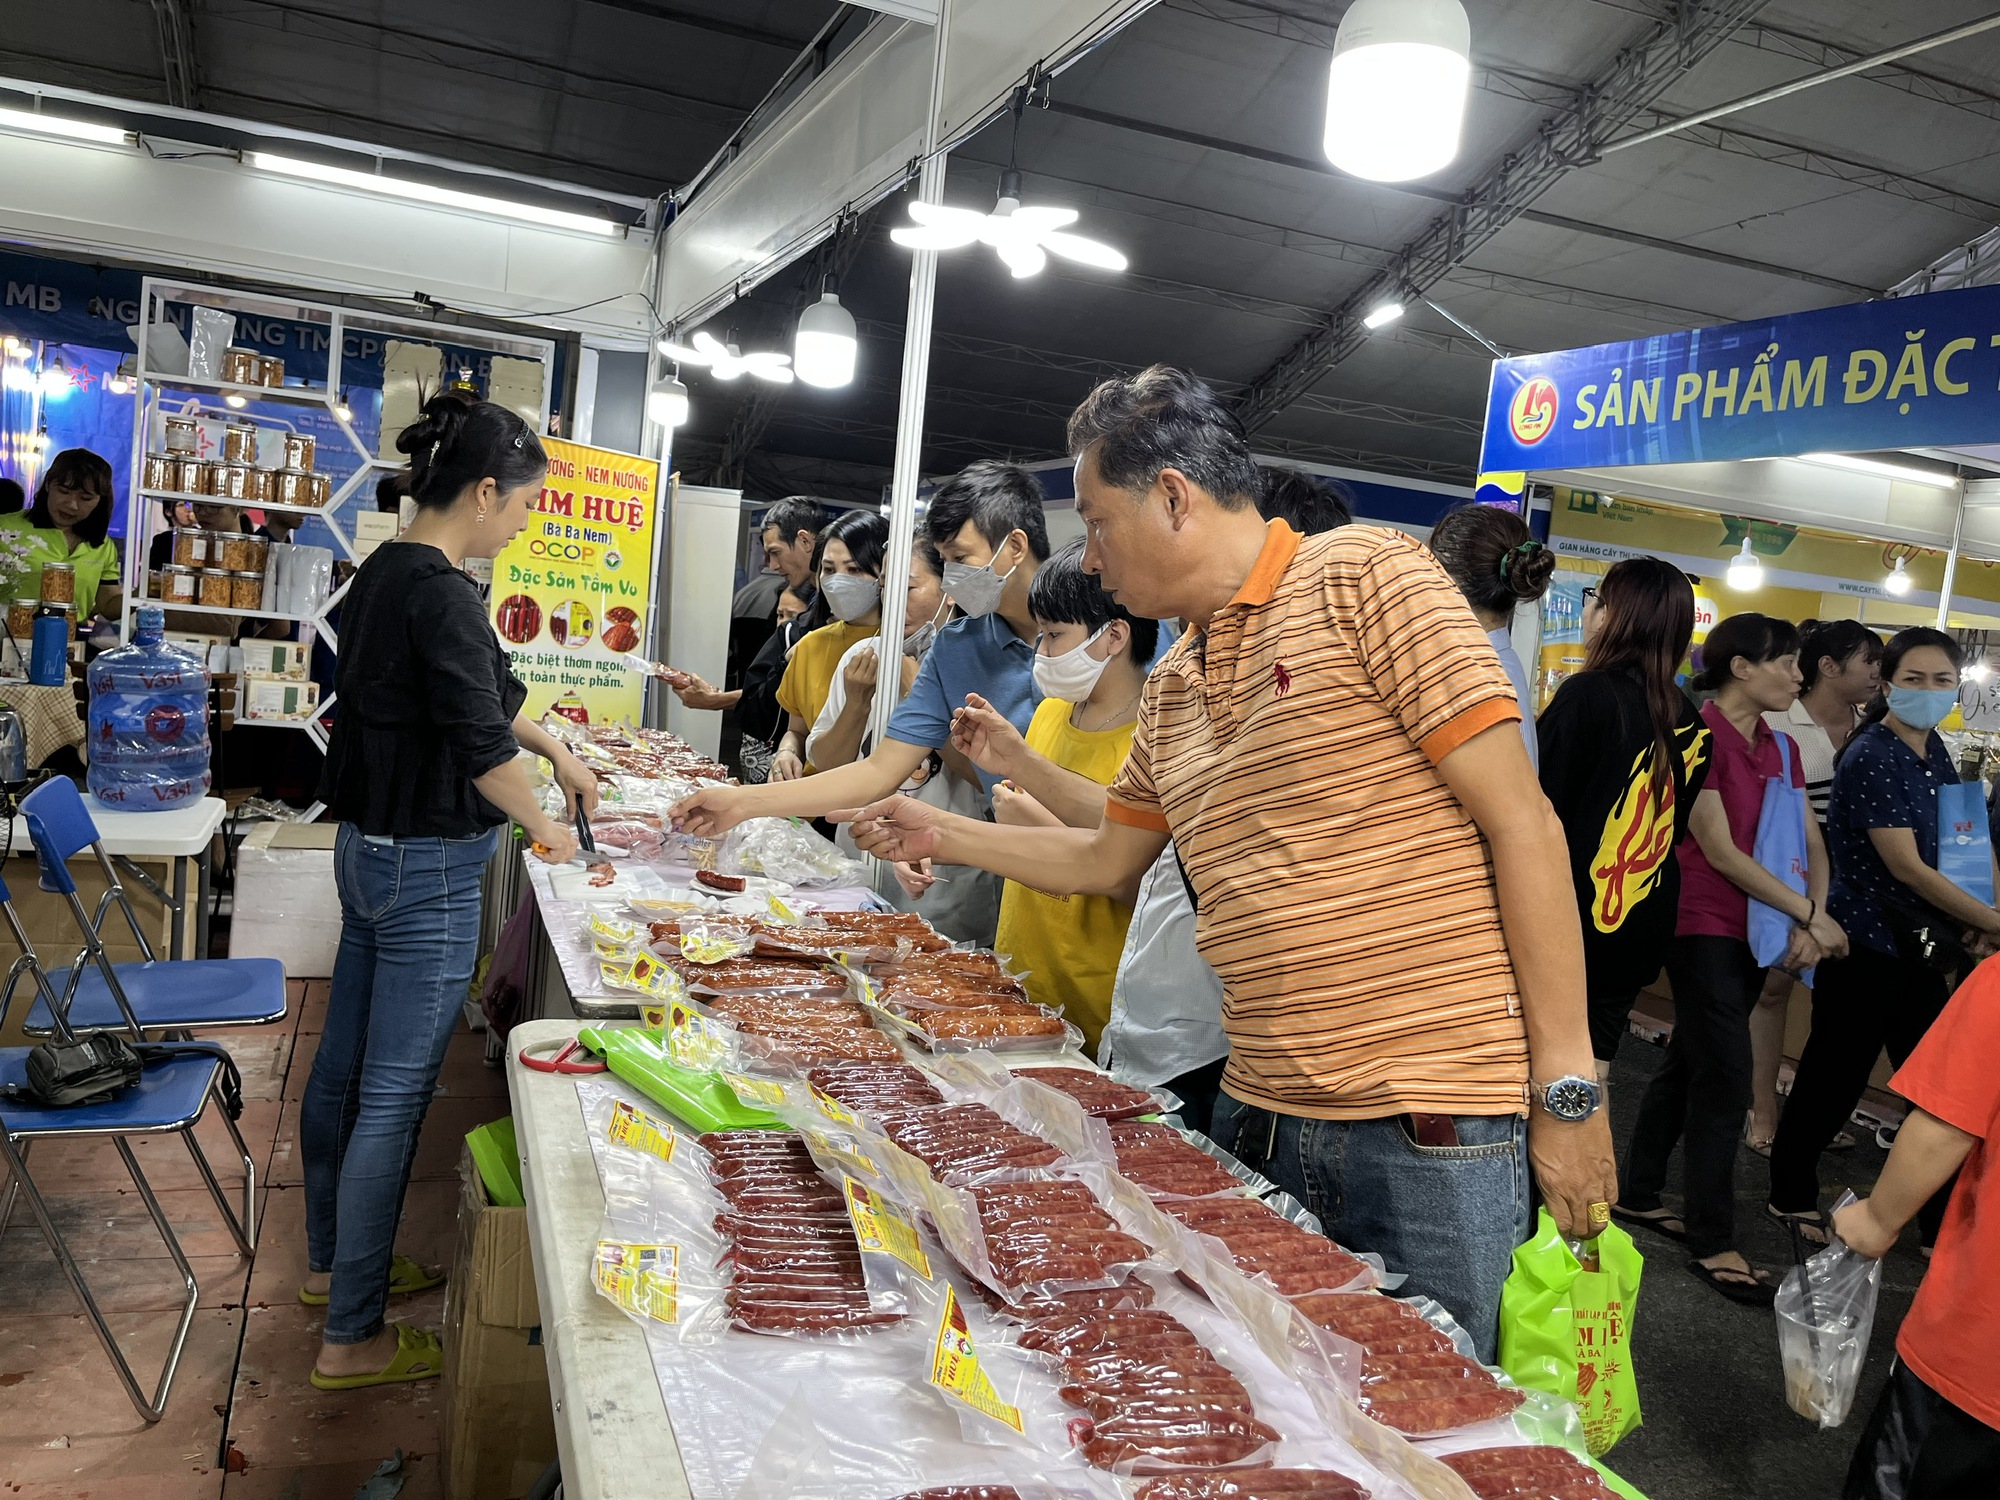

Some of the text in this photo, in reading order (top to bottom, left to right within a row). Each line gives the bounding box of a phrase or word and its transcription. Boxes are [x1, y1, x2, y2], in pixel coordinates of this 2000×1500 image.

[5, 281, 62, 313] MB
[1572, 367, 1661, 431] SẢN
[1672, 342, 1828, 421] PHẨM
[1842, 328, 1977, 415] ĐẶC
[546, 455, 575, 478] ƯỞNG
[585, 465, 609, 485] NEM
[612, 471, 648, 492] NƯỚNG
[531, 487, 644, 533] IM HUỆ
[1617, 513, 1634, 522] Nam
[565, 525, 580, 540] Ba
[583, 527, 612, 546] Nem)
[530, 539, 595, 561] OCOP
[1559, 543, 1578, 552] GIAN
[1579, 544, 1601, 555] HÀNG
[509, 564, 541, 590] Đặc
[545, 570, 576, 589] Sản
[581, 572, 613, 595] Tầm
[511, 651, 533, 668] Đặc
[537, 653, 560, 669] biệt
[564, 656, 592, 669] thơm
[139, 671, 183, 690] Vast
[530, 670, 556, 683] toàn
[560, 673, 586, 688] thực
[589, 673, 624, 688] phẩm.
[93, 786, 126, 803] Vast
[152, 781, 191, 802] Vast
